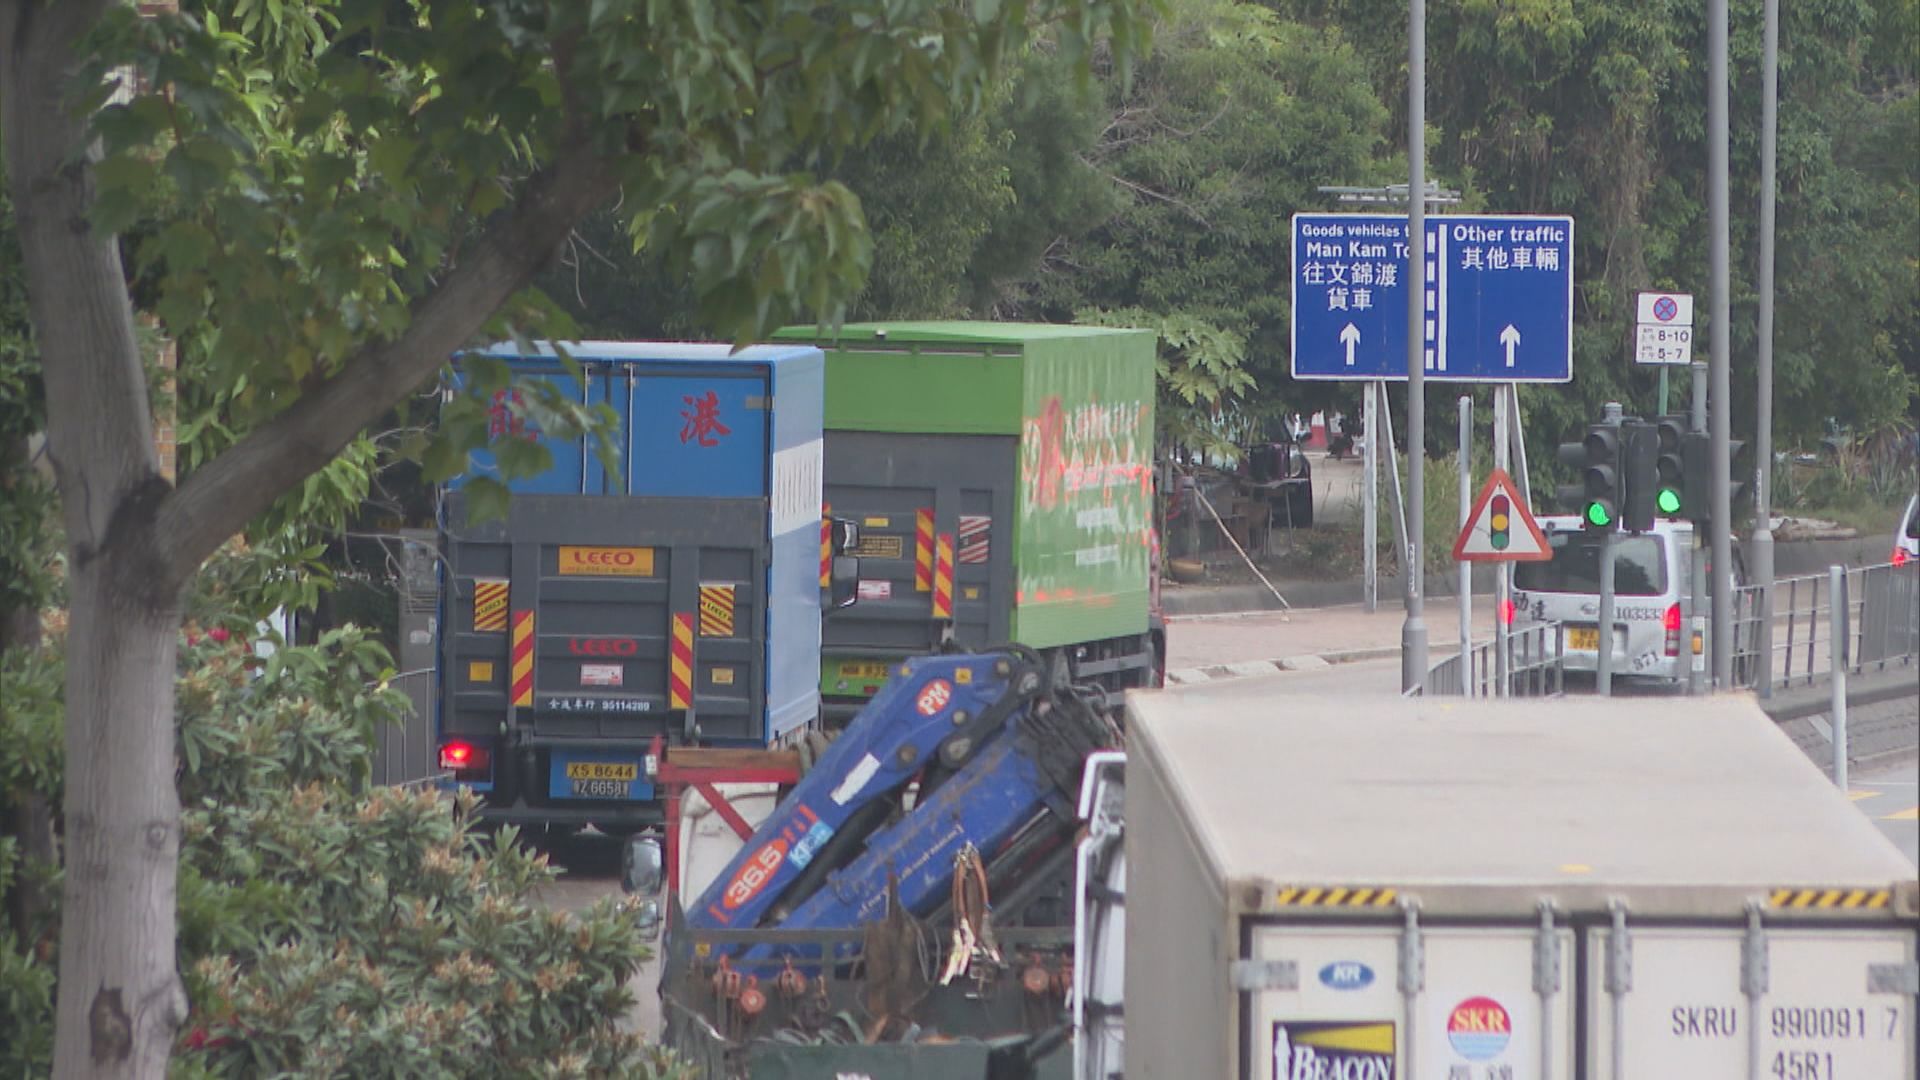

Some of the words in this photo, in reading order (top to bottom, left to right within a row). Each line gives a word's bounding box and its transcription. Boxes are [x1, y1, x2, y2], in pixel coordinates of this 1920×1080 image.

[1302, 224, 1344, 237] Goods
[1348, 224, 1400, 237] vehicles
[1453, 226, 1504, 243] Other
[1510, 226, 1564, 243] traffic
[1307, 242, 1342, 257] Man
[1349, 242, 1387, 257] Kam
[1461, 246, 1559, 270] 其他車輛
[1302, 260, 1397, 286] 往文錦渡
[1327, 287, 1372, 311] 貨車
[1658, 330, 1689, 342] 8-10
[1658, 348, 1682, 359] 5-7
[680, 391, 731, 447] 港
[574, 550, 635, 566] LEEO
[919, 682, 950, 716] PM
[571, 763, 590, 778] XS
[1453, 1007, 1505, 1033] SKR
[1672, 1007, 1737, 1036] SKRU
[1771, 1007, 1865, 1038] 990091
[1885, 1007, 1898, 1038] 7
[1293, 1045, 1392, 1080] BEACON
[1771, 1051, 1833, 1080] 45R1
